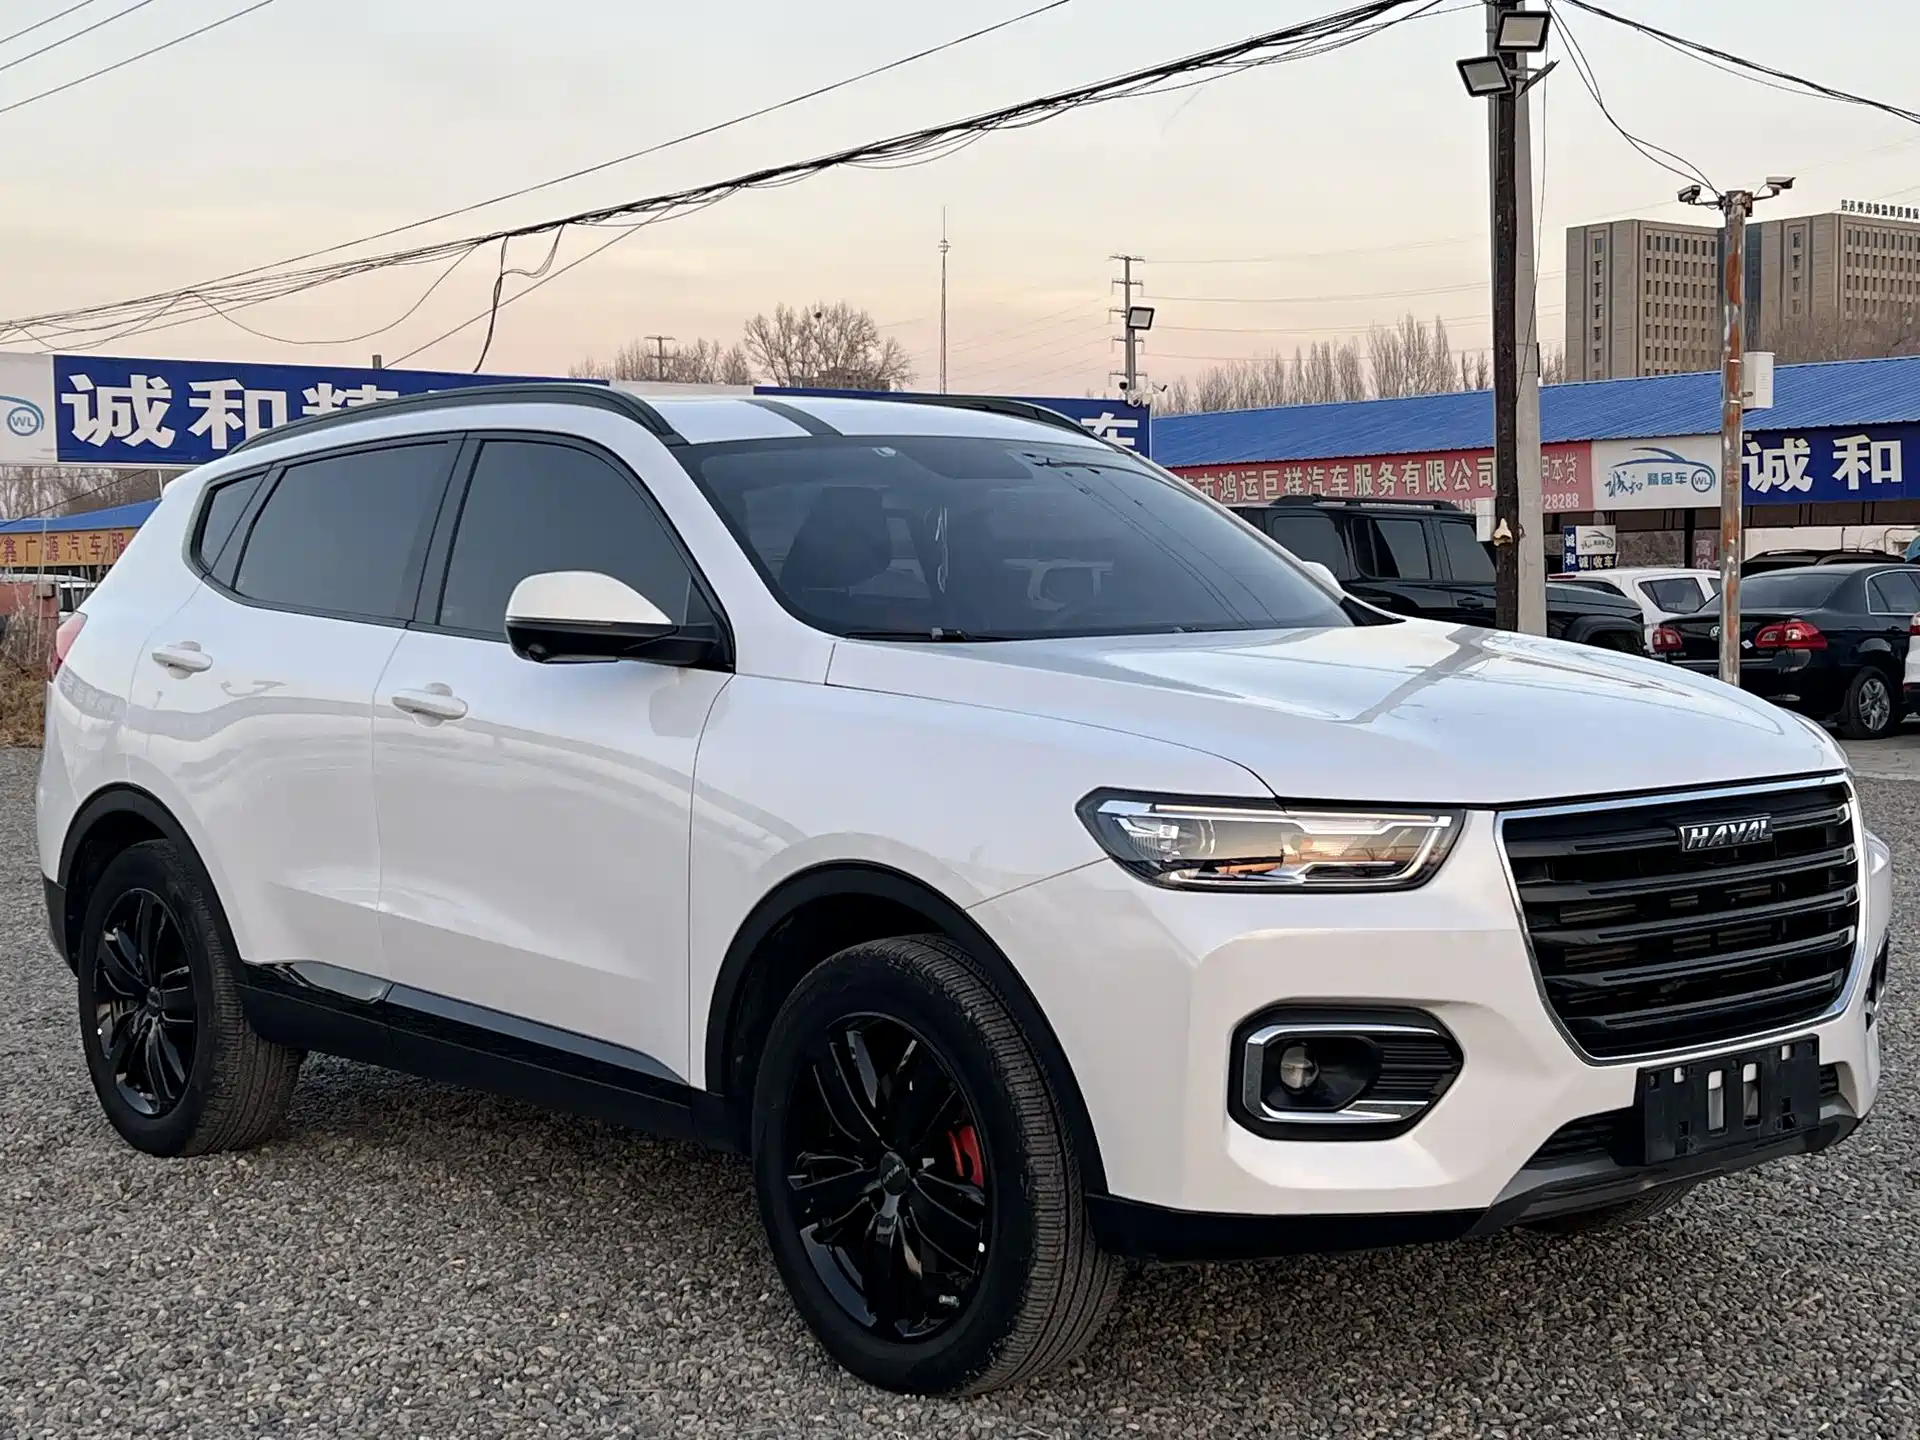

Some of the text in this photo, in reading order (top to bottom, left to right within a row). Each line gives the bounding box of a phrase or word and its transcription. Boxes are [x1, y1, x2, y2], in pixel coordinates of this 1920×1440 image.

[1184, 457, 1497, 502] 市鸿运巨祥汽车服务有限公司
[1742, 434, 1903, 493] 诚和
[1541, 492, 1579, 510] 28288
[1687, 820, 1772, 849] HAVAL
